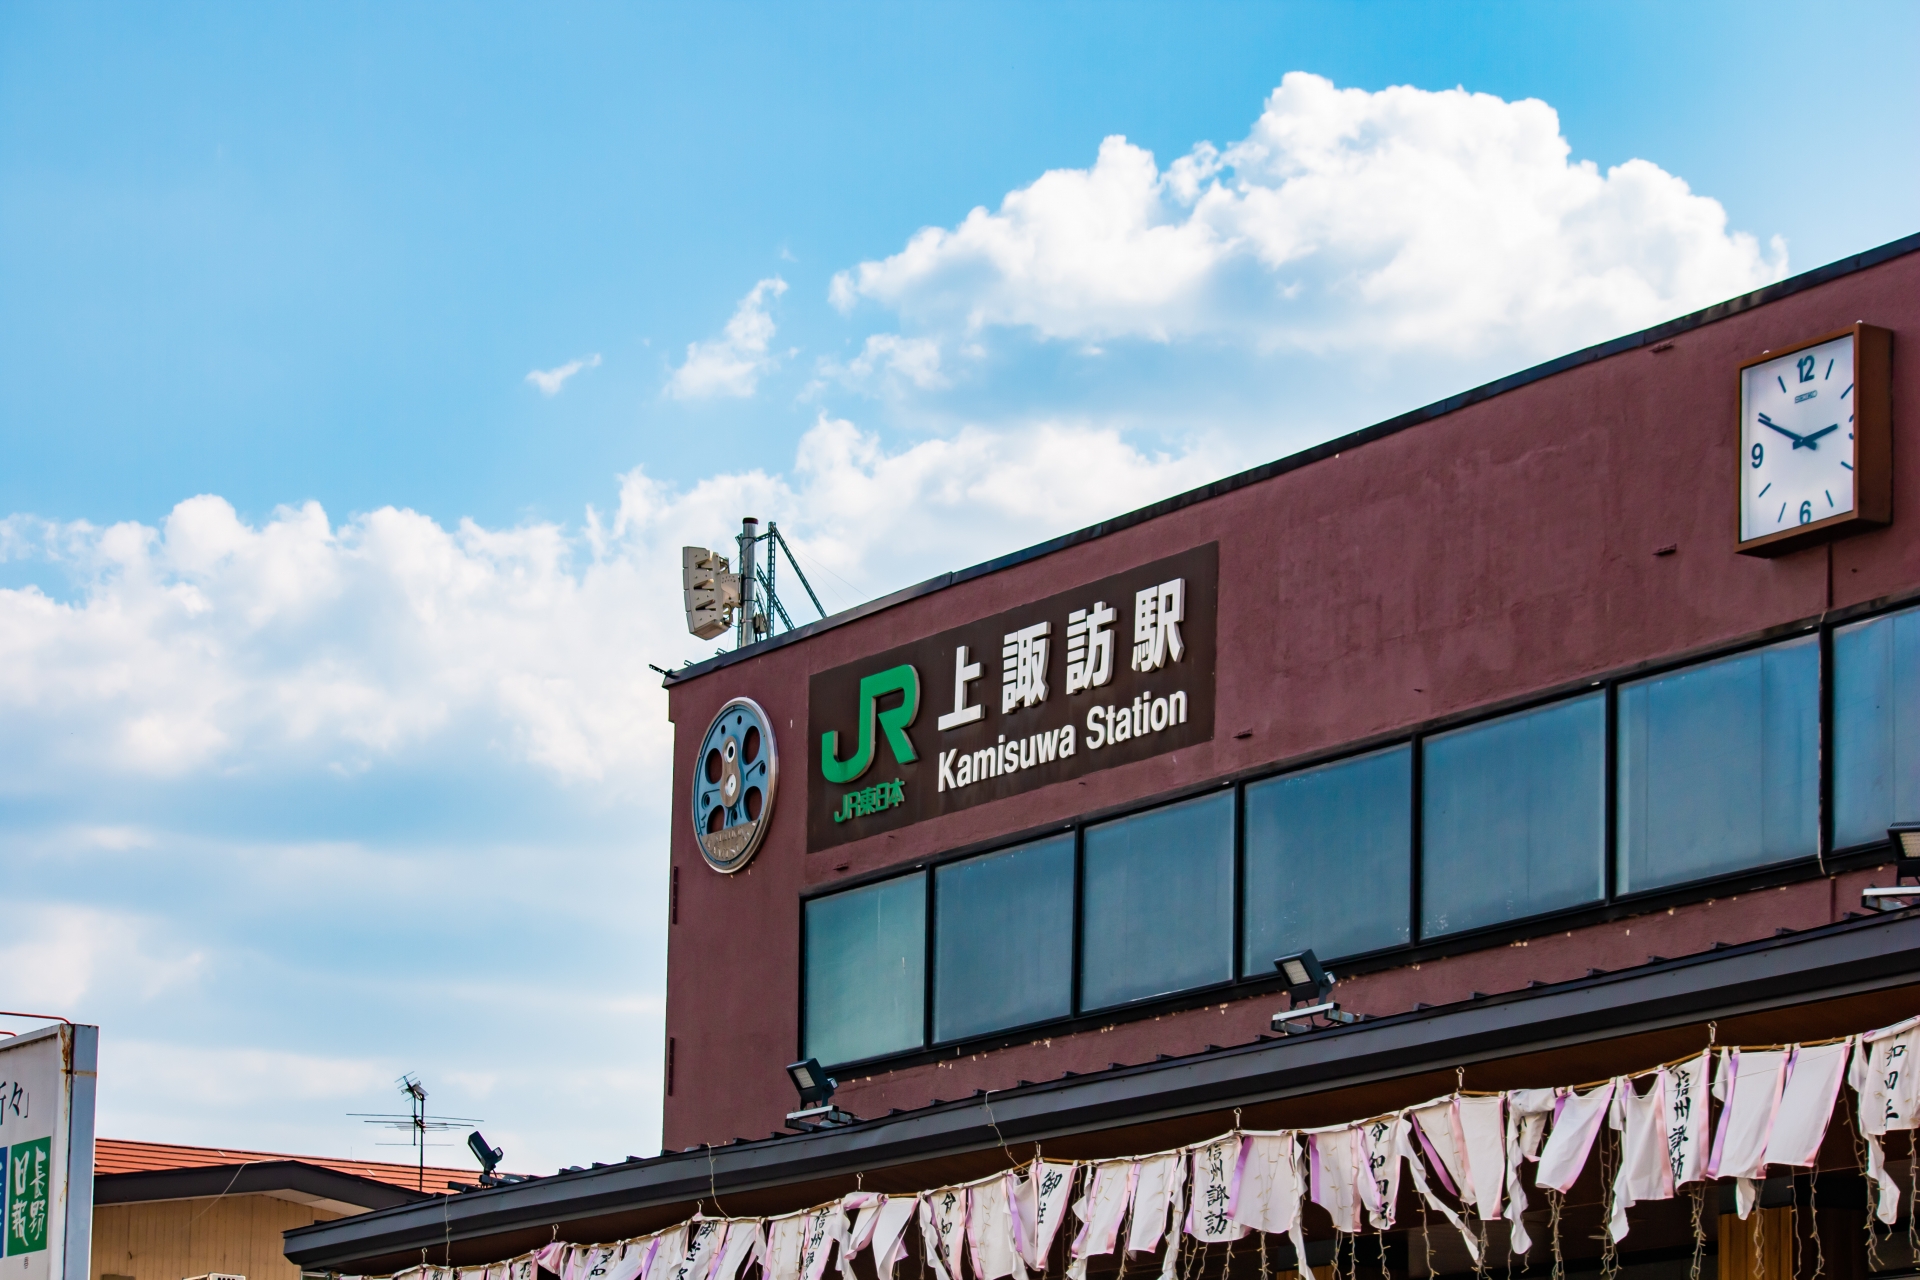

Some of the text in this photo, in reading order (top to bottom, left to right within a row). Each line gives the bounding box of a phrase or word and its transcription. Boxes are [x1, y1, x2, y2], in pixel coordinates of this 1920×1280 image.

[1797, 355, 1815, 383] 12
[1751, 443, 1764, 468] 9
[1800, 501, 1812, 524] 6
[938, 578, 1186, 731] 上諏訪駅
[821, 664, 920, 784] JR
[938, 691, 1188, 792] Kamisuwa Station
[834, 777, 905, 822] JR東日本
[1204, 1143, 1231, 1236] 信州諏訪
